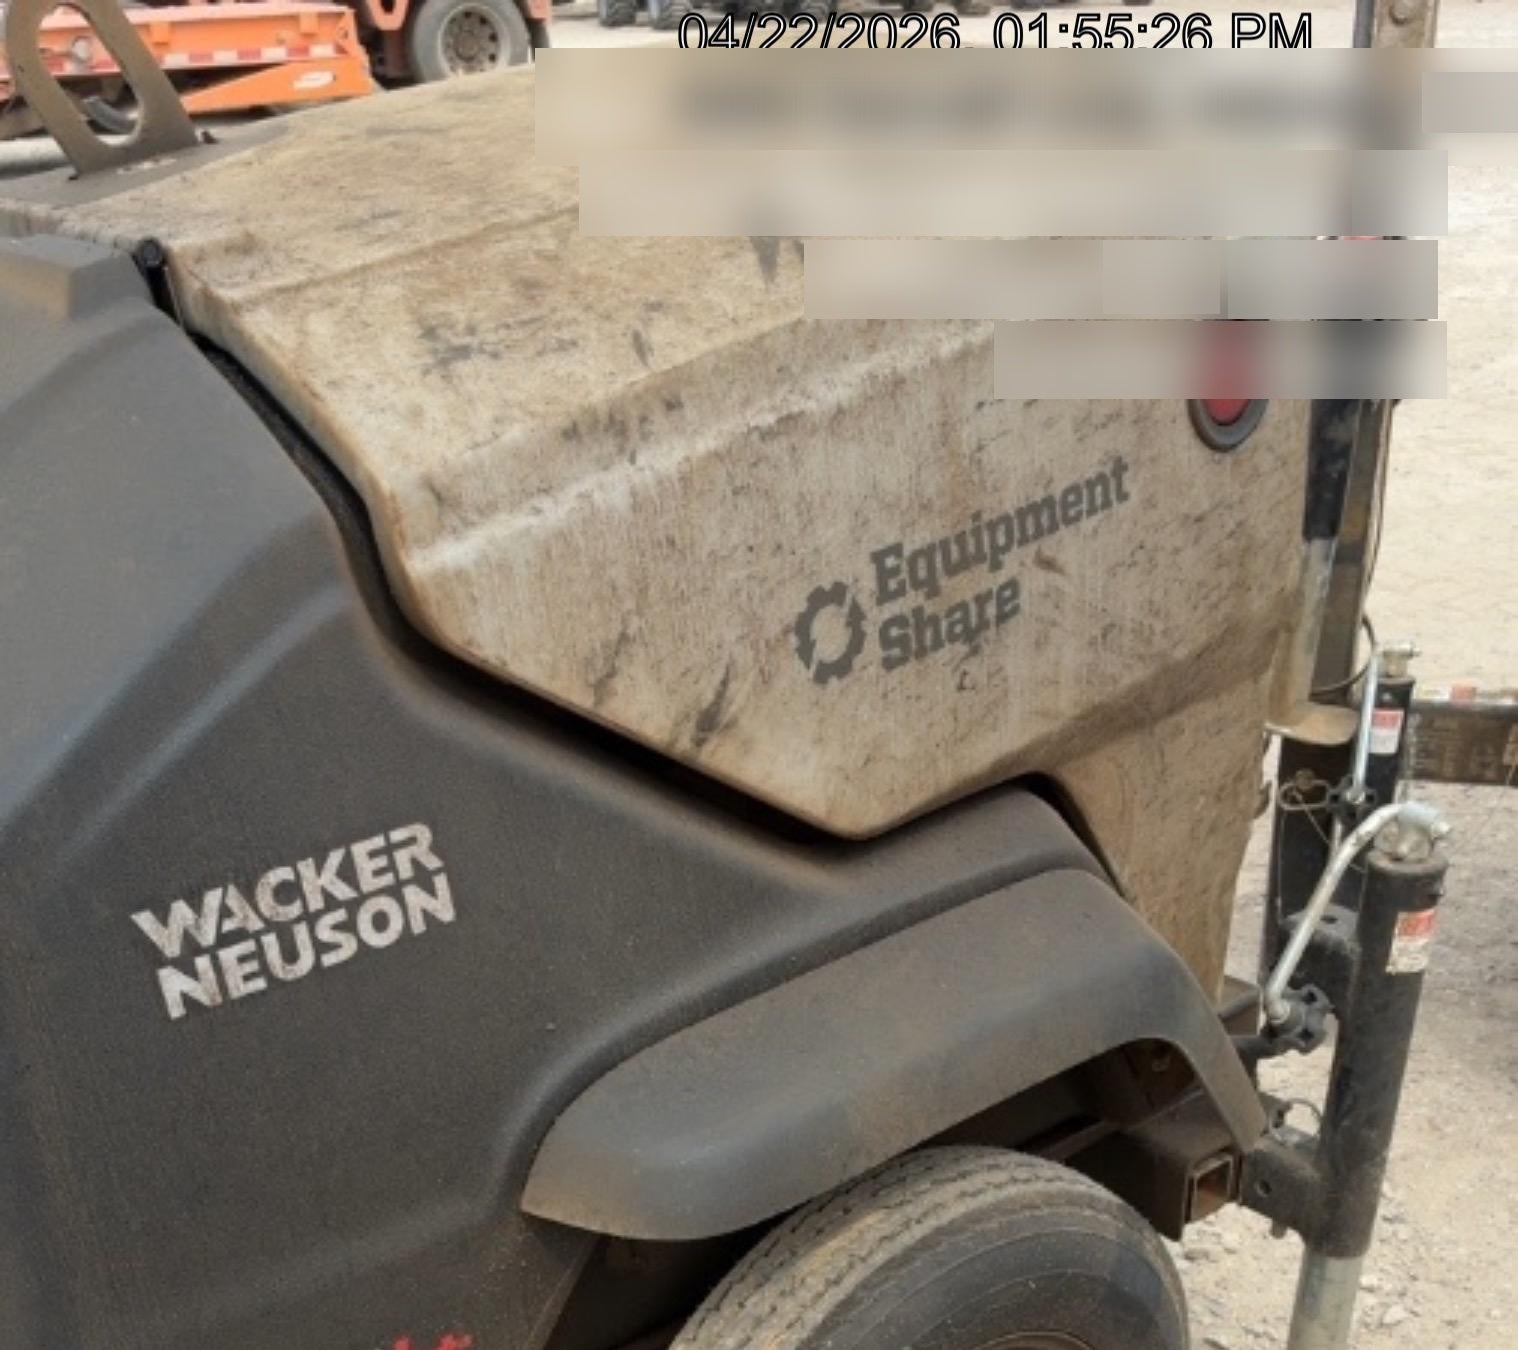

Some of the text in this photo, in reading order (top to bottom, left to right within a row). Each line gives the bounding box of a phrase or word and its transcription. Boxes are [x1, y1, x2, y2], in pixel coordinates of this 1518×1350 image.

[870, 455, 1131, 607] Equipment
[878, 577, 1021, 672] Share
[130, 823, 445, 959] WACKER
[157, 872, 456, 1021] NEUSON
